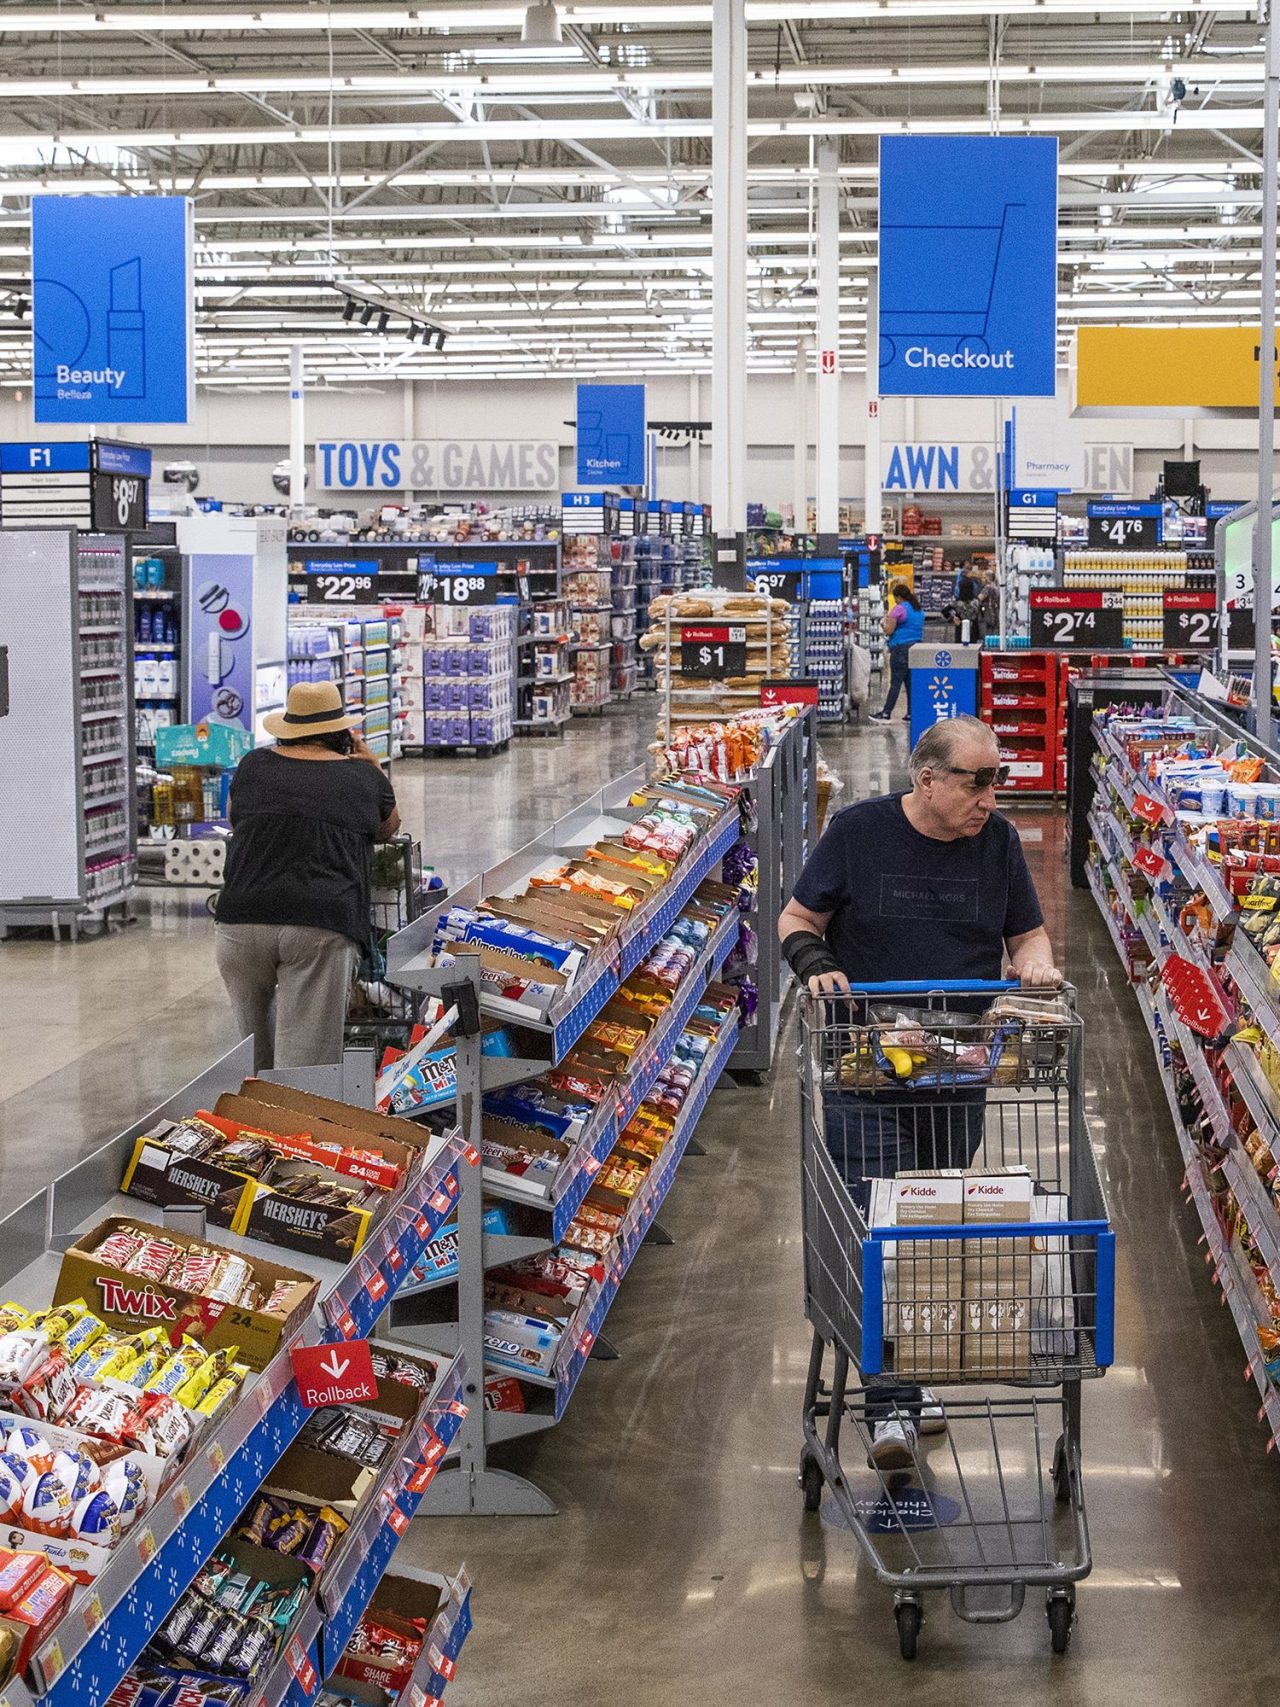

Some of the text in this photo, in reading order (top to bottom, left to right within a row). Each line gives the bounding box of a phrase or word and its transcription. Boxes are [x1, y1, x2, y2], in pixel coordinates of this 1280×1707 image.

[905, 347, 1015, 369] Checkout
[56, 364, 126, 389] Beauty
[57, 389, 92, 400] Belleza
[29, 448, 51, 467] F1
[319, 443, 556, 488] TOYS & GAMES
[586, 459, 621, 469] Kitchen
[1026, 461, 1070, 472] Pharmacy
[882, 446, 993, 490] AWN &
[1022, 493, 1037, 505] G1
[1236, 574, 1245, 590] 3
[1043, 595, 1071, 603] Rollback
[699, 646, 724, 666] $1
[1182, 1014, 1210, 1035] Rollback
[168, 1167, 221, 1199] HERSHEY'S
[911, 1186, 937, 1196] Kidde
[978, 1185, 1004, 1195] Kidde
[264, 1199, 328, 1231] HERSHEY'S
[96, 1276, 176, 1320] Twix
[230, 1312, 251, 1328] 24
[306, 1382, 371, 1404] Rollback
[856, 1508, 933, 1517] Checkou
[363, 1666, 392, 1684] SHARE
